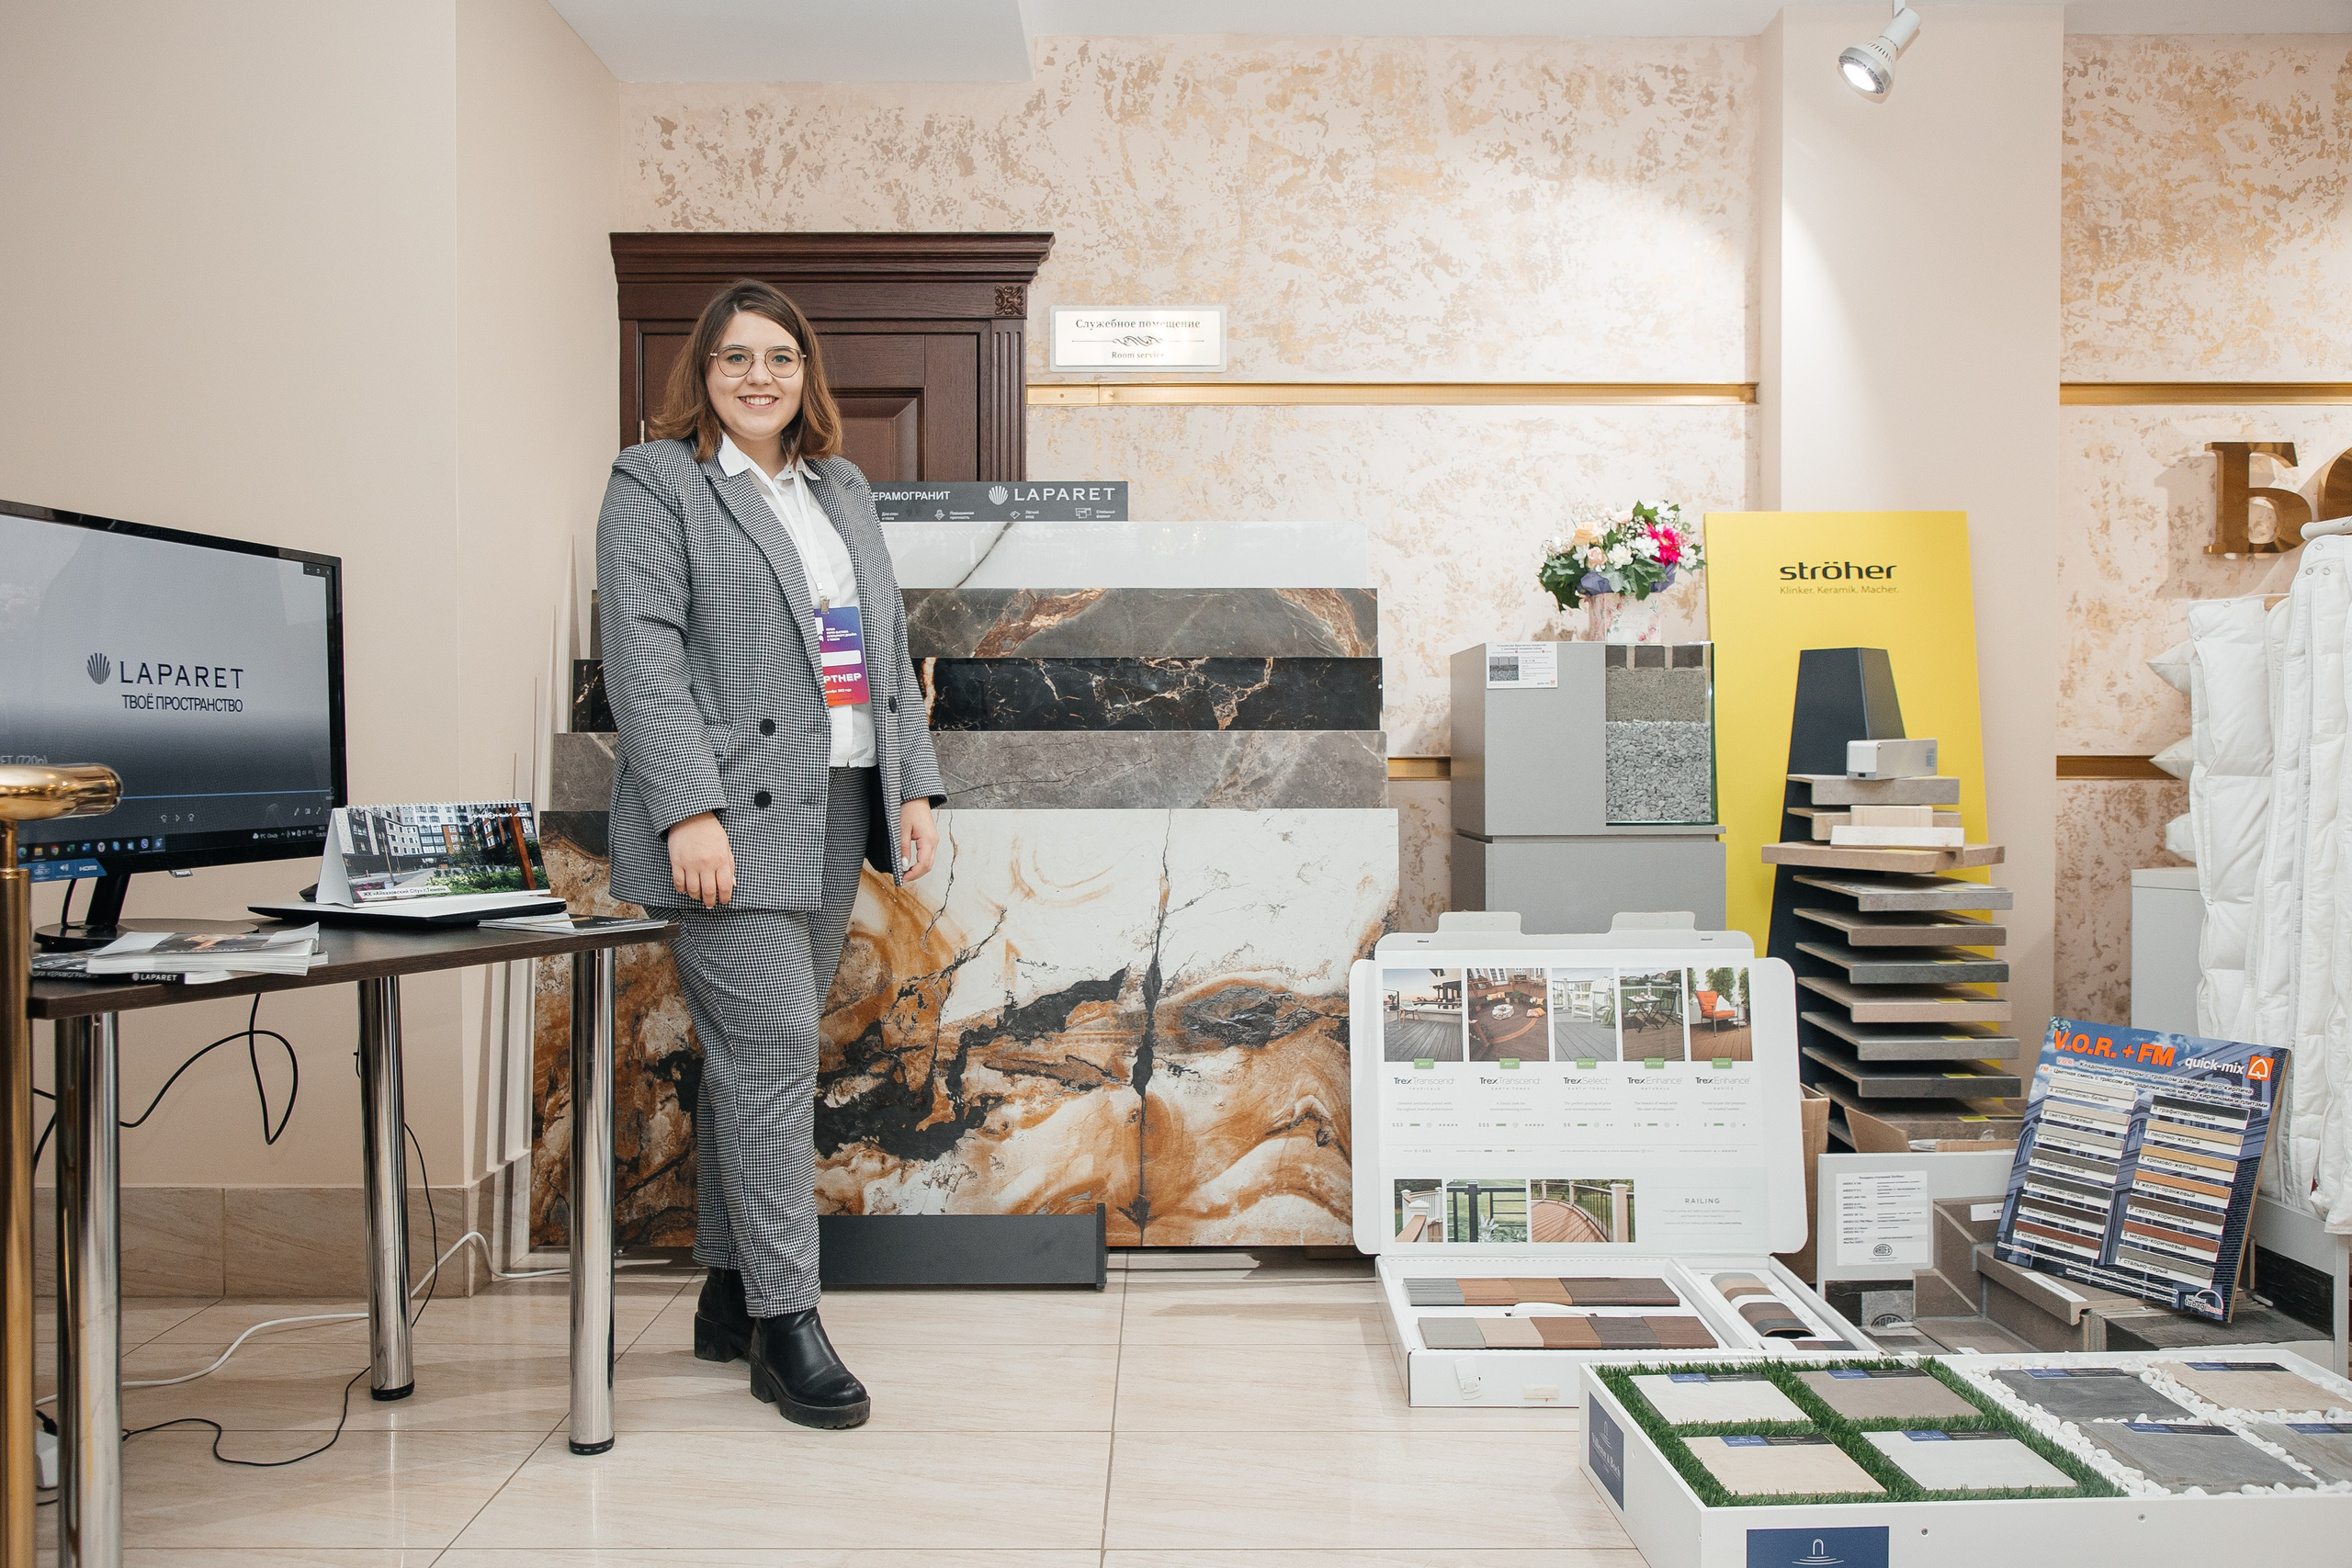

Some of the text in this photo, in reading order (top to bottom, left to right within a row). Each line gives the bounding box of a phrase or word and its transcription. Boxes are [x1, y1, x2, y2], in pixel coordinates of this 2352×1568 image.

[1076, 320, 1136, 331] Служебное
[873, 491, 950, 502] ЕРАМОГРАНИТ
[1014, 488, 1115, 502] LAPARET
[1780, 561, 1897, 581] ströher
[1780, 585, 1899, 594] Klinker. Keramik. Macher.
[120, 660, 243, 689] LAPARET
[823, 672, 862, 683] РТНЕР
[121, 694, 243, 712] ТВОЁ ПРОСТРАНСТВО
[2054, 1031, 2176, 1067] V.O.R. + FM
[2185, 1056, 2245, 1075] quick-mix
[1394, 1077, 1412, 1085] Trex
[1479, 1077, 1498, 1085] Trex
[1563, 1077, 1582, 1085] Trex
[2079, 1062, 2113, 1071] Кладочные
[2114, 1068, 2144, 1077] растворы
[2151, 1074, 2177, 1083] трассом
[2192, 1080, 2222, 1089] лицевого
[2223, 1086, 2253, 1094] кирпича
[2053, 1068, 2076, 1077] Цветная
[2135, 1083, 2160, 1091] заделки
[2177, 1089, 2198, 1098] между
[2199, 1093, 2234, 1103] кирпичами
[2054, 1089, 2109, 1102] алебастрово-белый
[2048, 1112, 2094, 1124] светло-бежевый
[2159, 1108, 2216, 1122] графитово-черный
[2042, 1136, 2081, 1147] светло-серый
[2151, 1133, 2200, 1145] песочно-желтый
[2037, 1160, 2086, 1174] графитово-серый
[2146, 1158, 2198, 1172] кремово-желтый
[2142, 1183, 2196, 1199] желто-оранжевый
[2135, 1208, 2194, 1225] светло-коричневый
[2129, 1234, 2187, 1251] медно-коричневый
[2123, 1259, 2169, 1275] стально-серый
